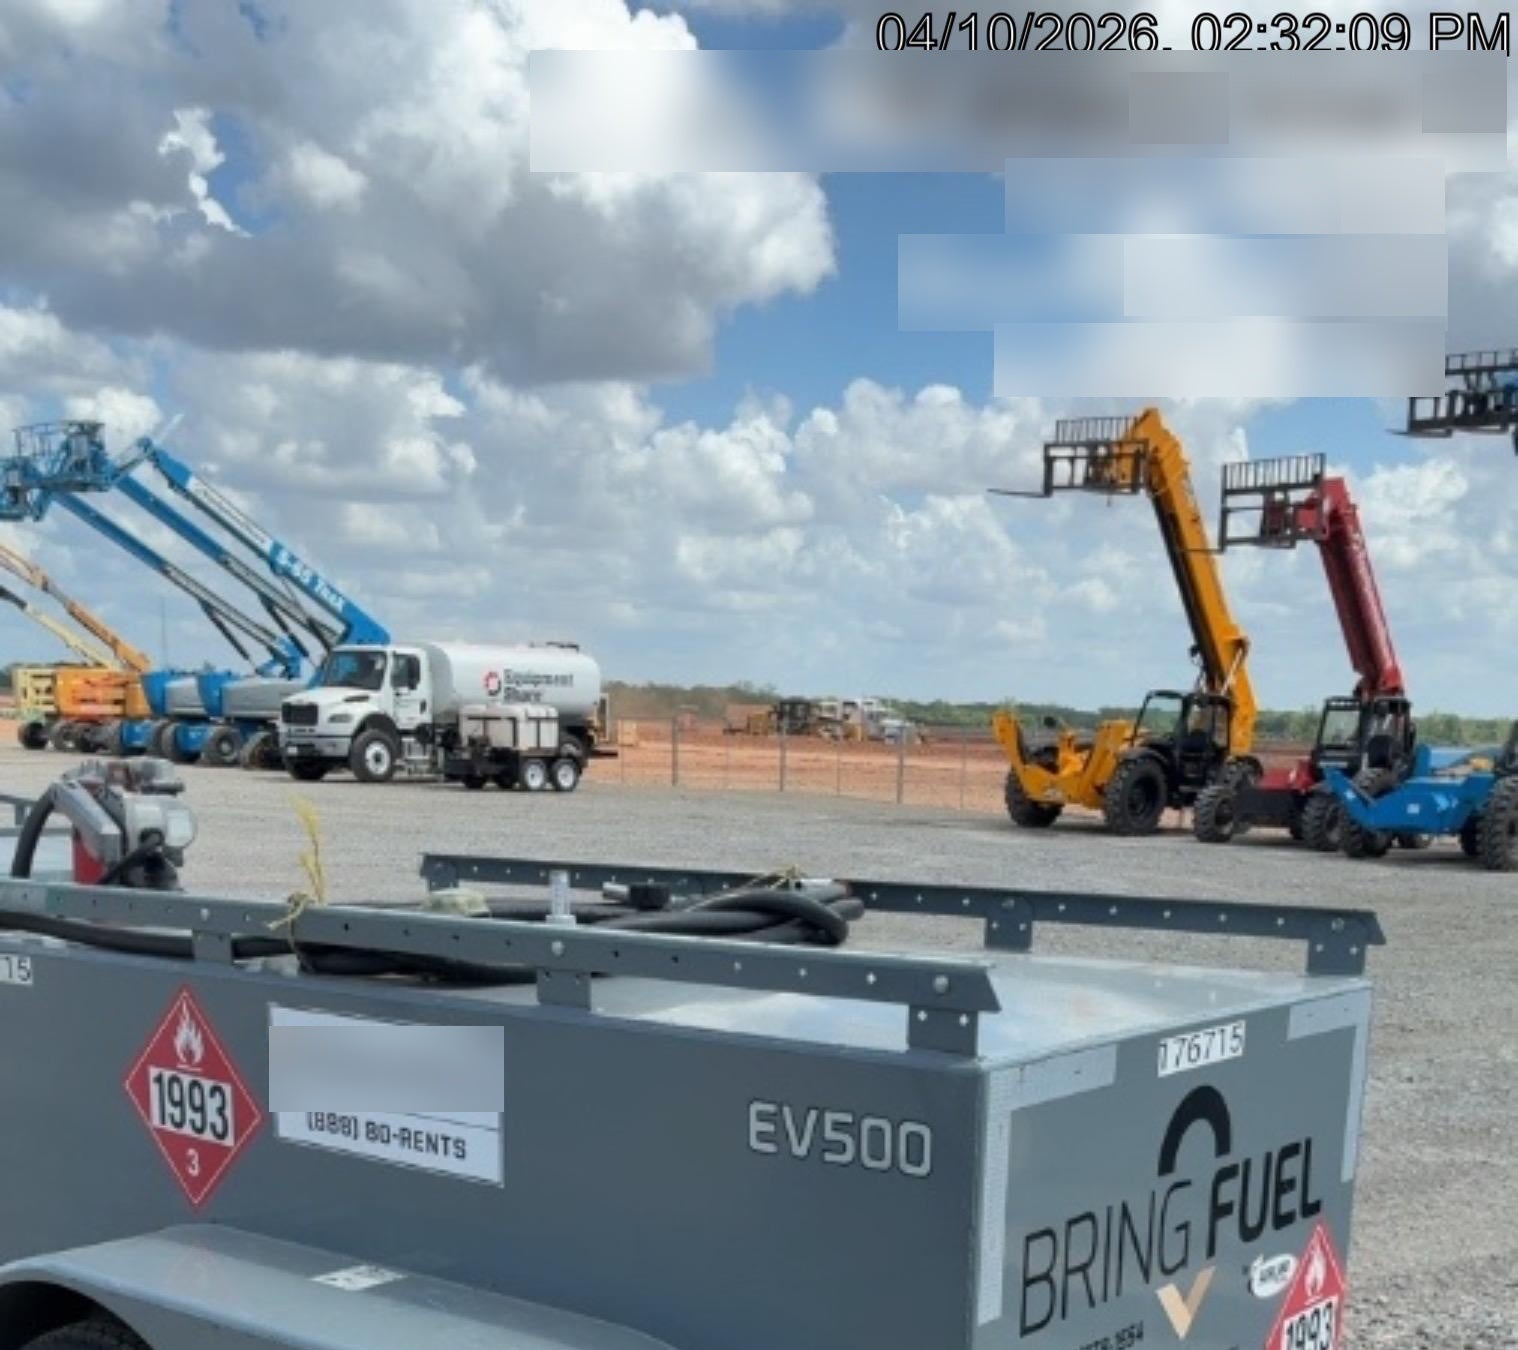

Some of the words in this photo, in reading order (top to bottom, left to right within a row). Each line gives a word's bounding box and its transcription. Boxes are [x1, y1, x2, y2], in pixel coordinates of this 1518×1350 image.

[1159, 1024, 1242, 1070] 176715
[152, 1070, 230, 1142] 1993
[185, 1148, 201, 1178] 3
[365, 1121, 467, 1160] 80-RENTS
[749, 1100, 932, 1177] EV500
[1020, 1179, 1192, 1338] BRING
[1207, 1137, 1322, 1260] FUEL
